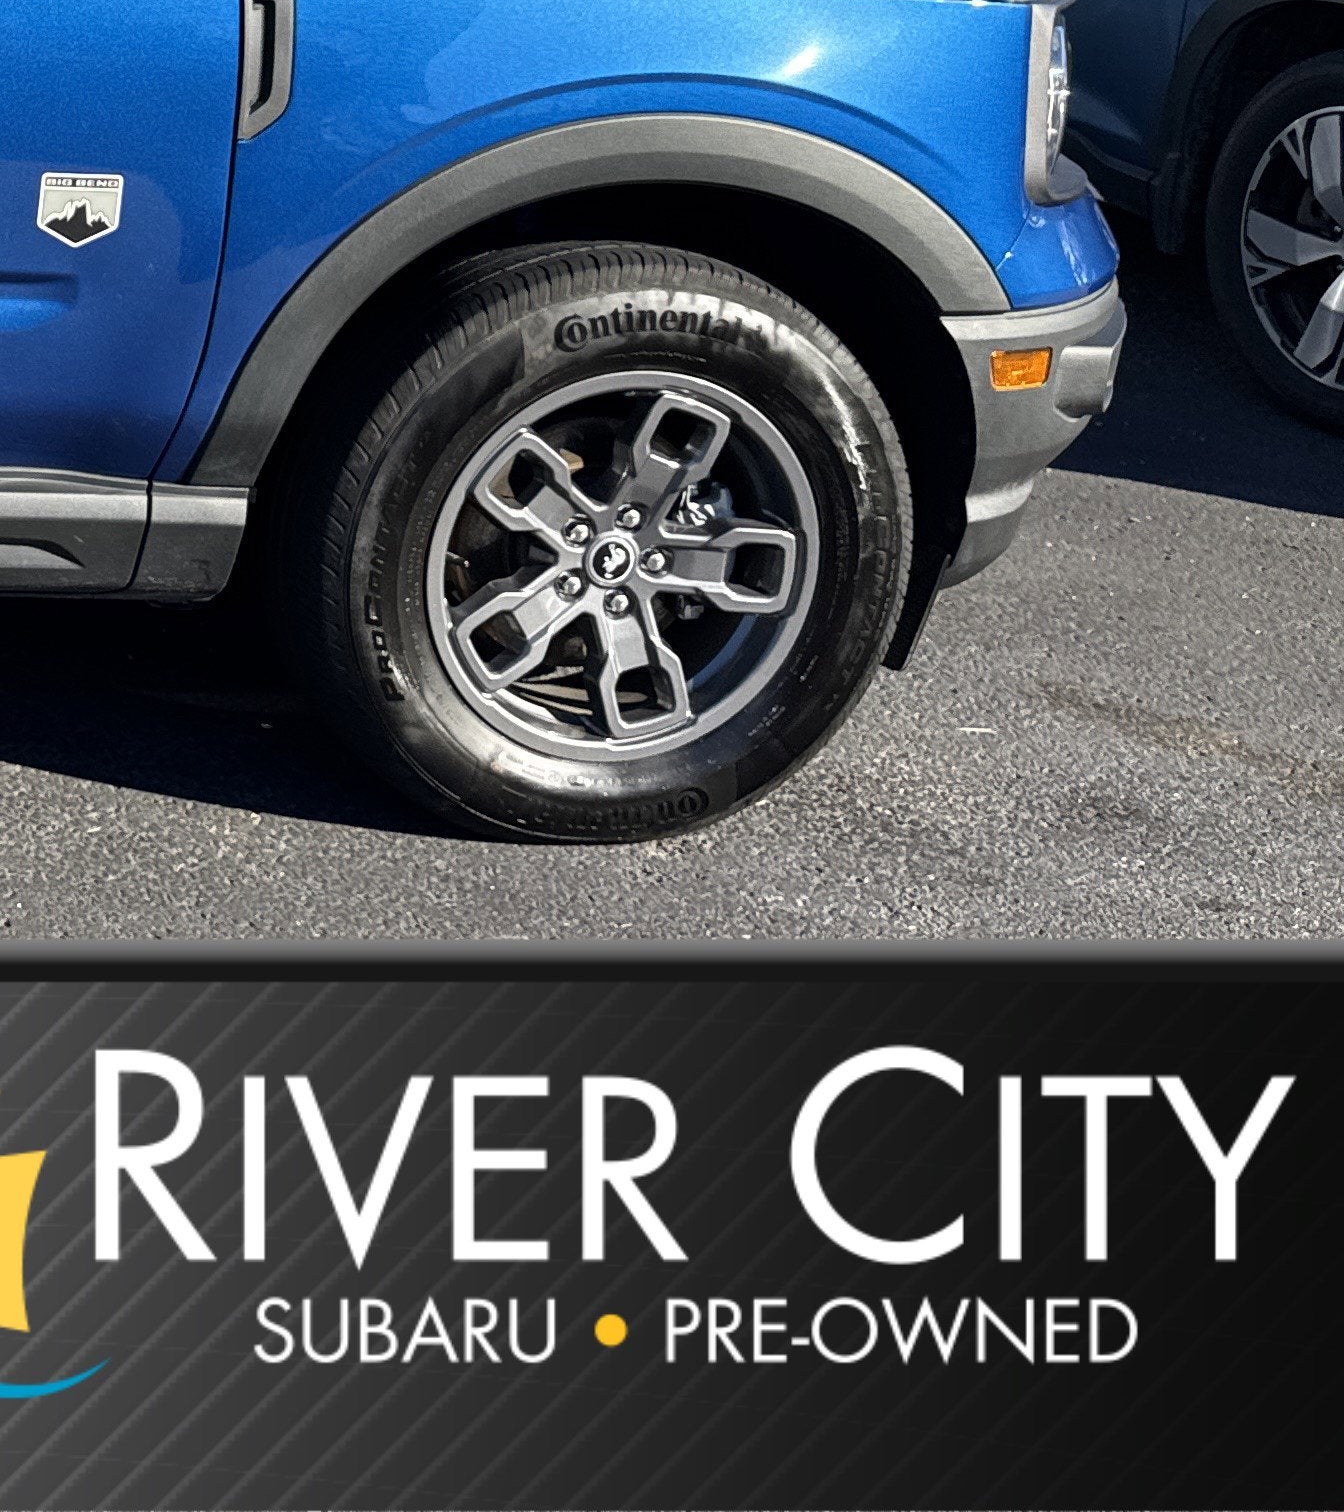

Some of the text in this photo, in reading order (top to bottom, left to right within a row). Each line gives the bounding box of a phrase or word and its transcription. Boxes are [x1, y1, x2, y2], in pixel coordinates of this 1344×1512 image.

[46, 178, 119, 188] BIG BEND
[554, 303, 742, 352] Continental
